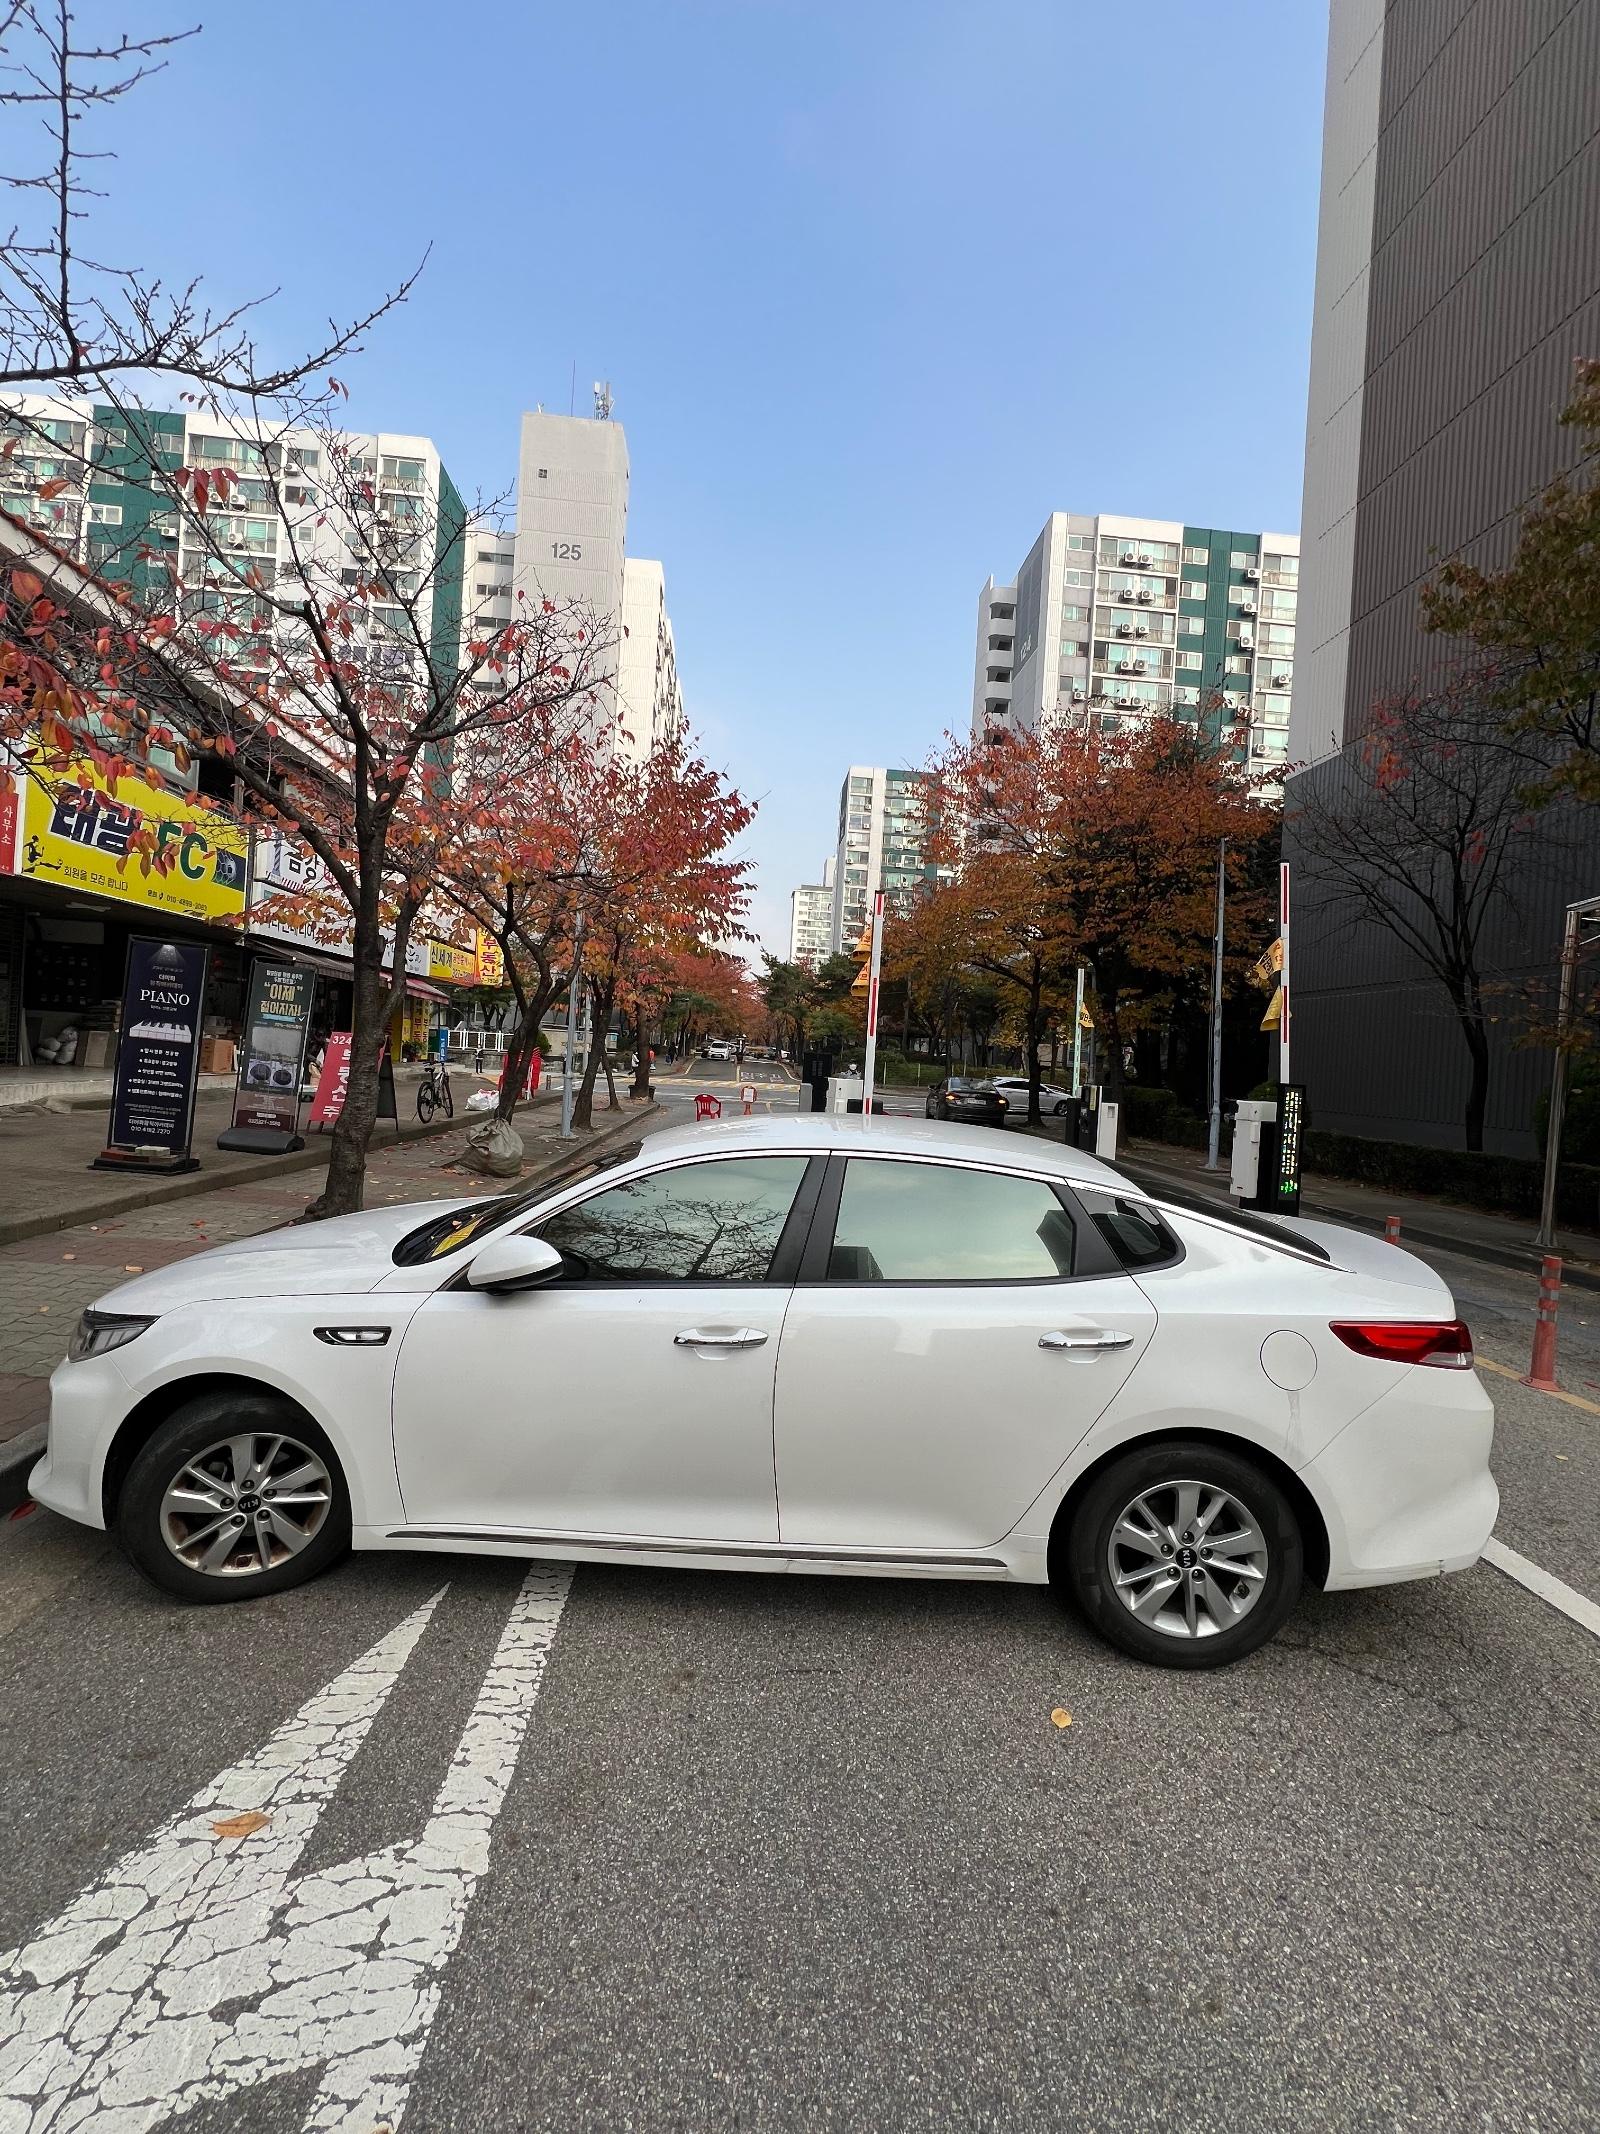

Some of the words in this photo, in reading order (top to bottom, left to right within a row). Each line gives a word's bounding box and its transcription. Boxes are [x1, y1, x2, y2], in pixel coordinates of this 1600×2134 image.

[552, 543, 582, 561] 125
[63, 865, 88, 881] 회원을
[90, 872, 106, 886] 모집
[140, 988, 190, 1006] PIANO
[239, 1498, 259, 1510] KIA
[1182, 1549, 1192, 1568] KIA
